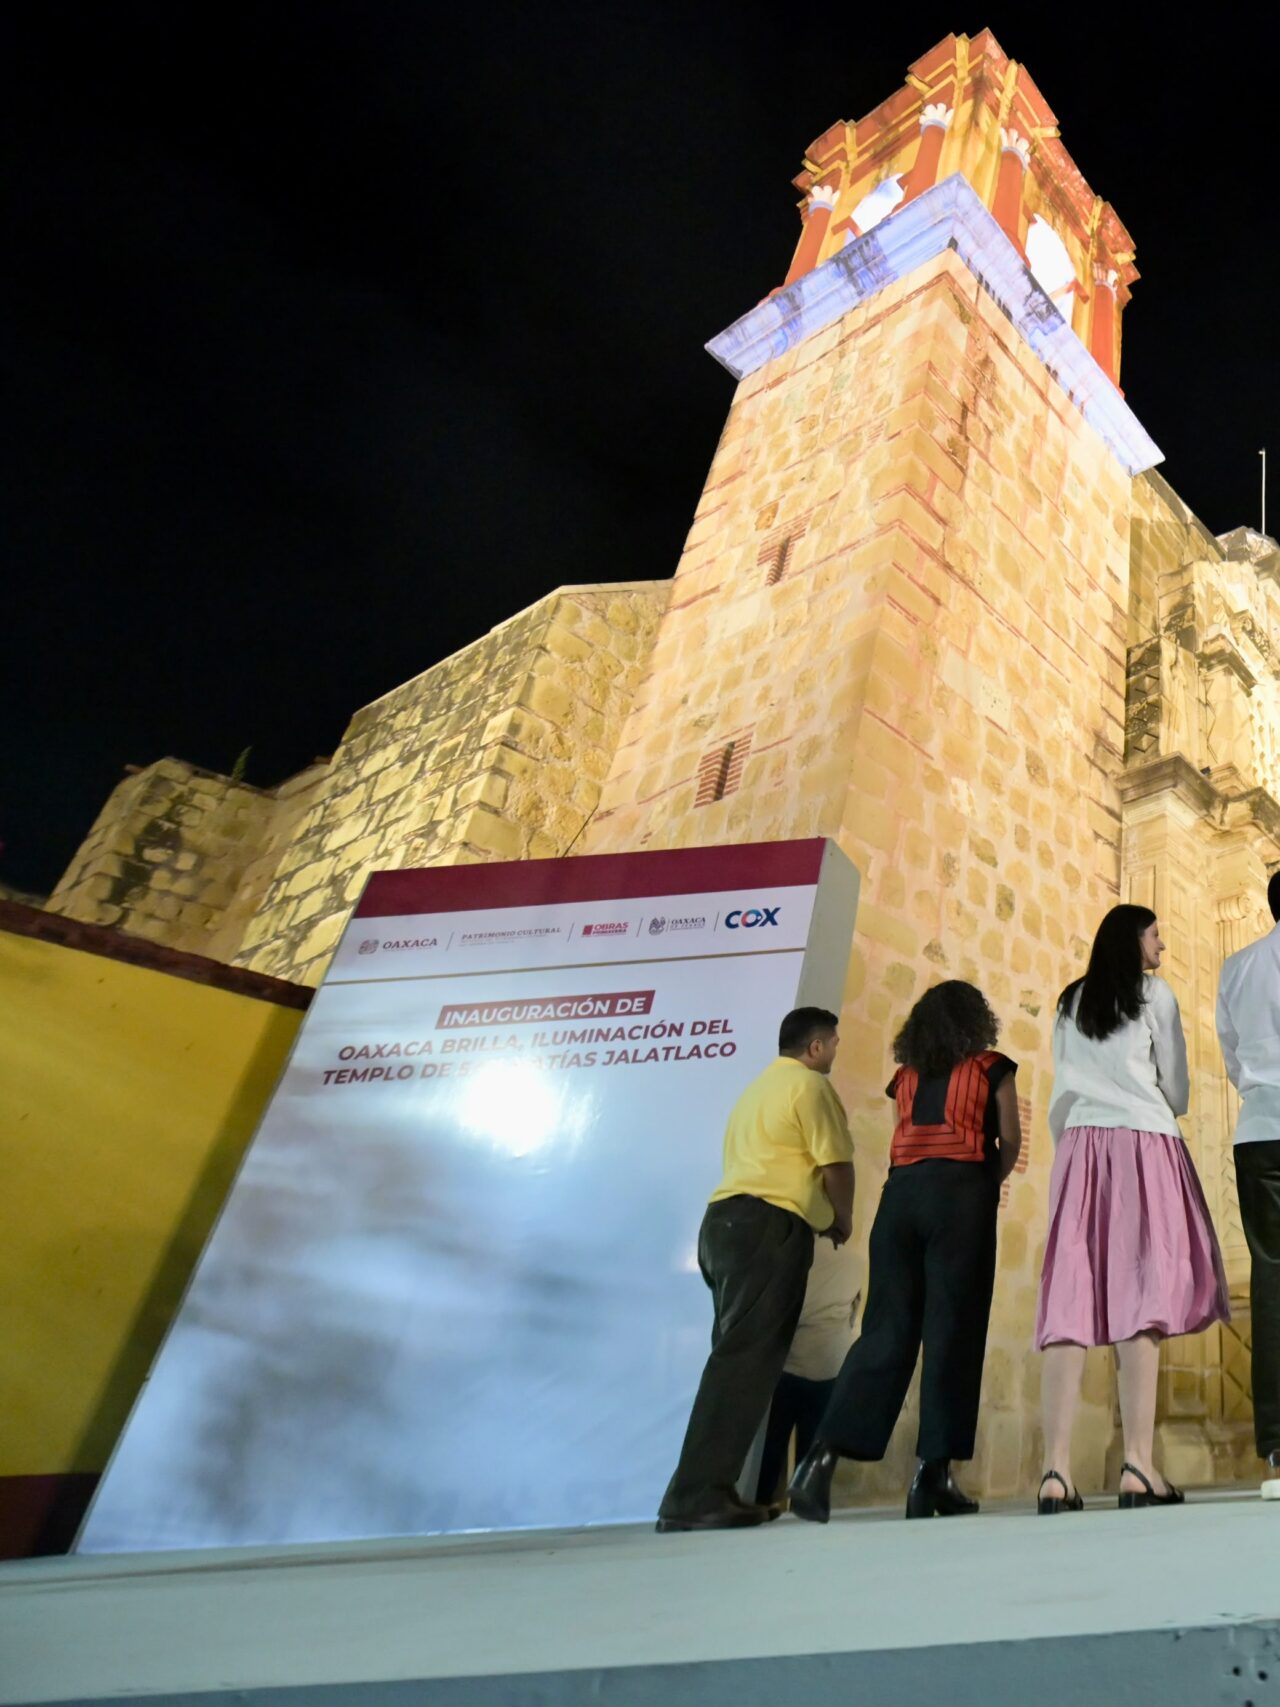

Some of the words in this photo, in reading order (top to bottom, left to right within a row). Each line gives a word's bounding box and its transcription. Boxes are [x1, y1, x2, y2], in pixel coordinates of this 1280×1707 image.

[594, 921, 630, 931] OBRAS
[671, 917, 706, 925] OAXACA
[725, 907, 781, 929] COX
[461, 930, 515, 941] PATRIMONIO
[517, 927, 561, 937] CULTURAL
[382, 938, 438, 950] OAXACA
[442, 997, 611, 1026] INAUGURACIÓN
[615, 997, 647, 1014] DE
[338, 1040, 434, 1061] OAXACA
[440, 1033, 525, 1054] BRILLA,
[530, 1019, 685, 1048] ILUMINACIÓN
[690, 1019, 734, 1036] DEL
[322, 1064, 415, 1085] TEMPLO
[419, 1062, 455, 1079] DE
[602, 1042, 737, 1066] JALATLACO
